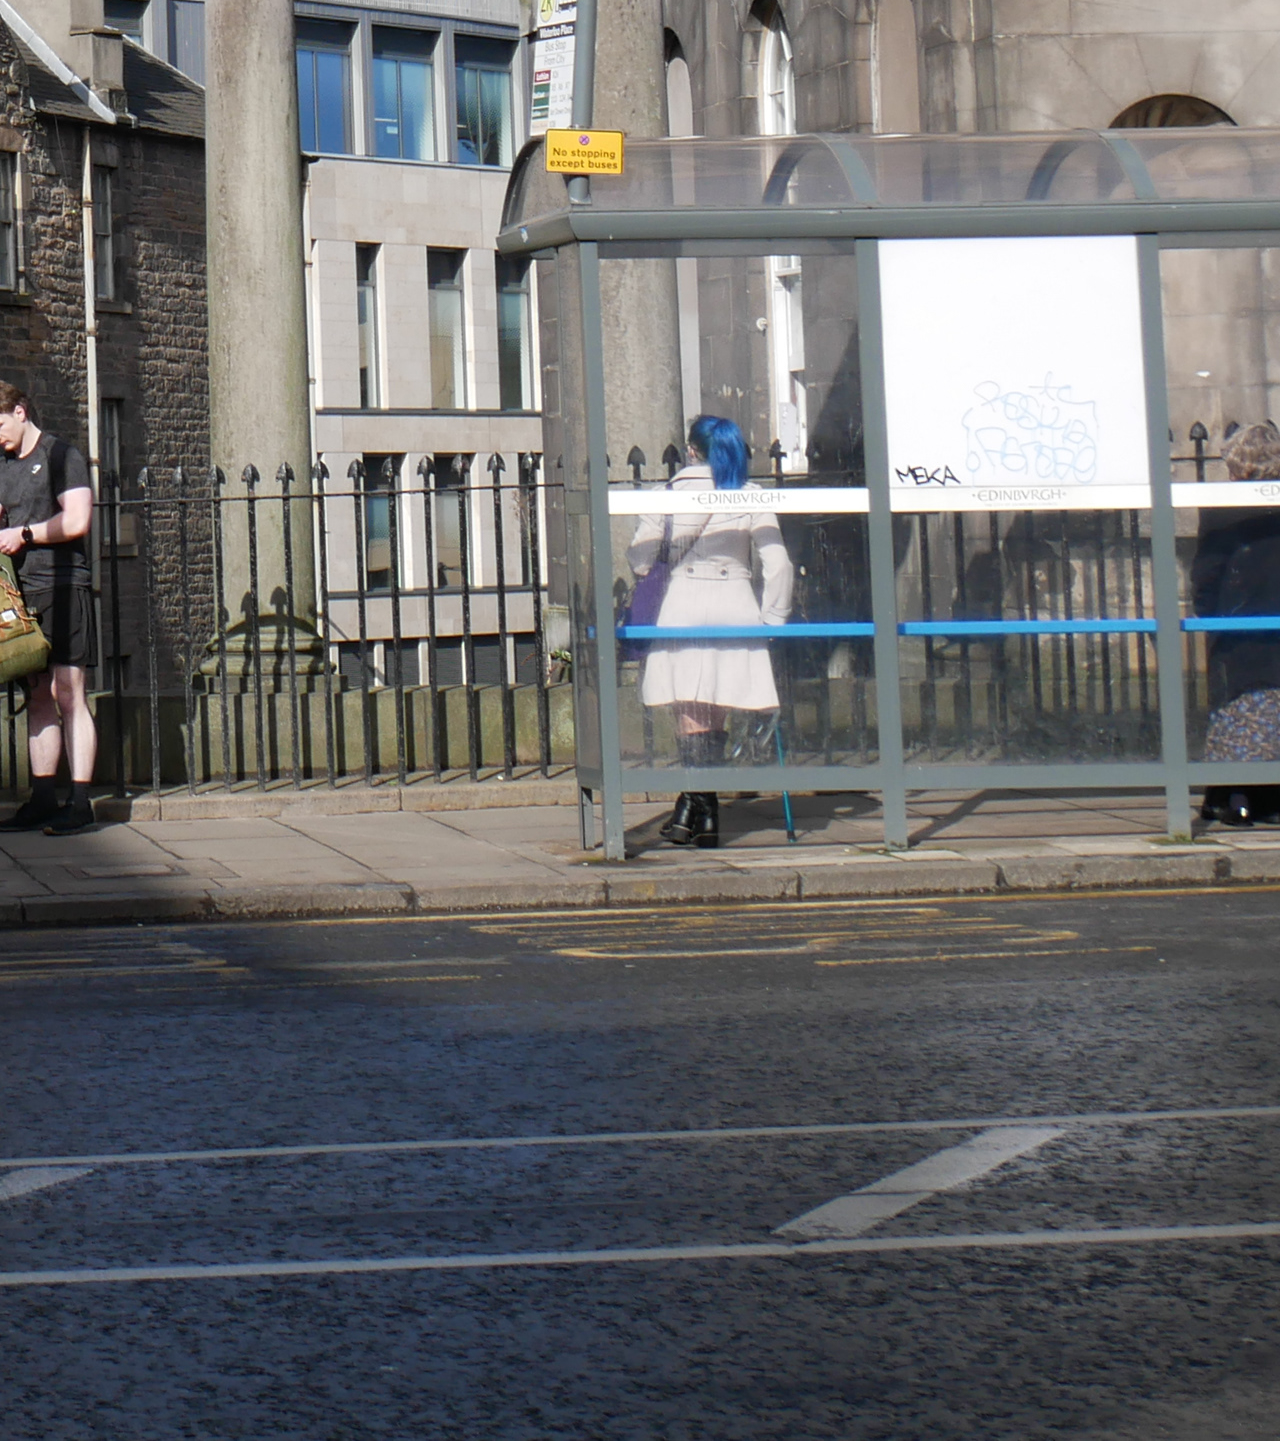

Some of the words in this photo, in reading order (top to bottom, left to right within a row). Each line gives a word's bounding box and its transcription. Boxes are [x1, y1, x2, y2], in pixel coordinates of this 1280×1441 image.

[552, 147, 568, 157] No
[571, 148, 616, 160] stopping
[550, 160, 584, 169] except
[588, 160, 618, 169] buses
